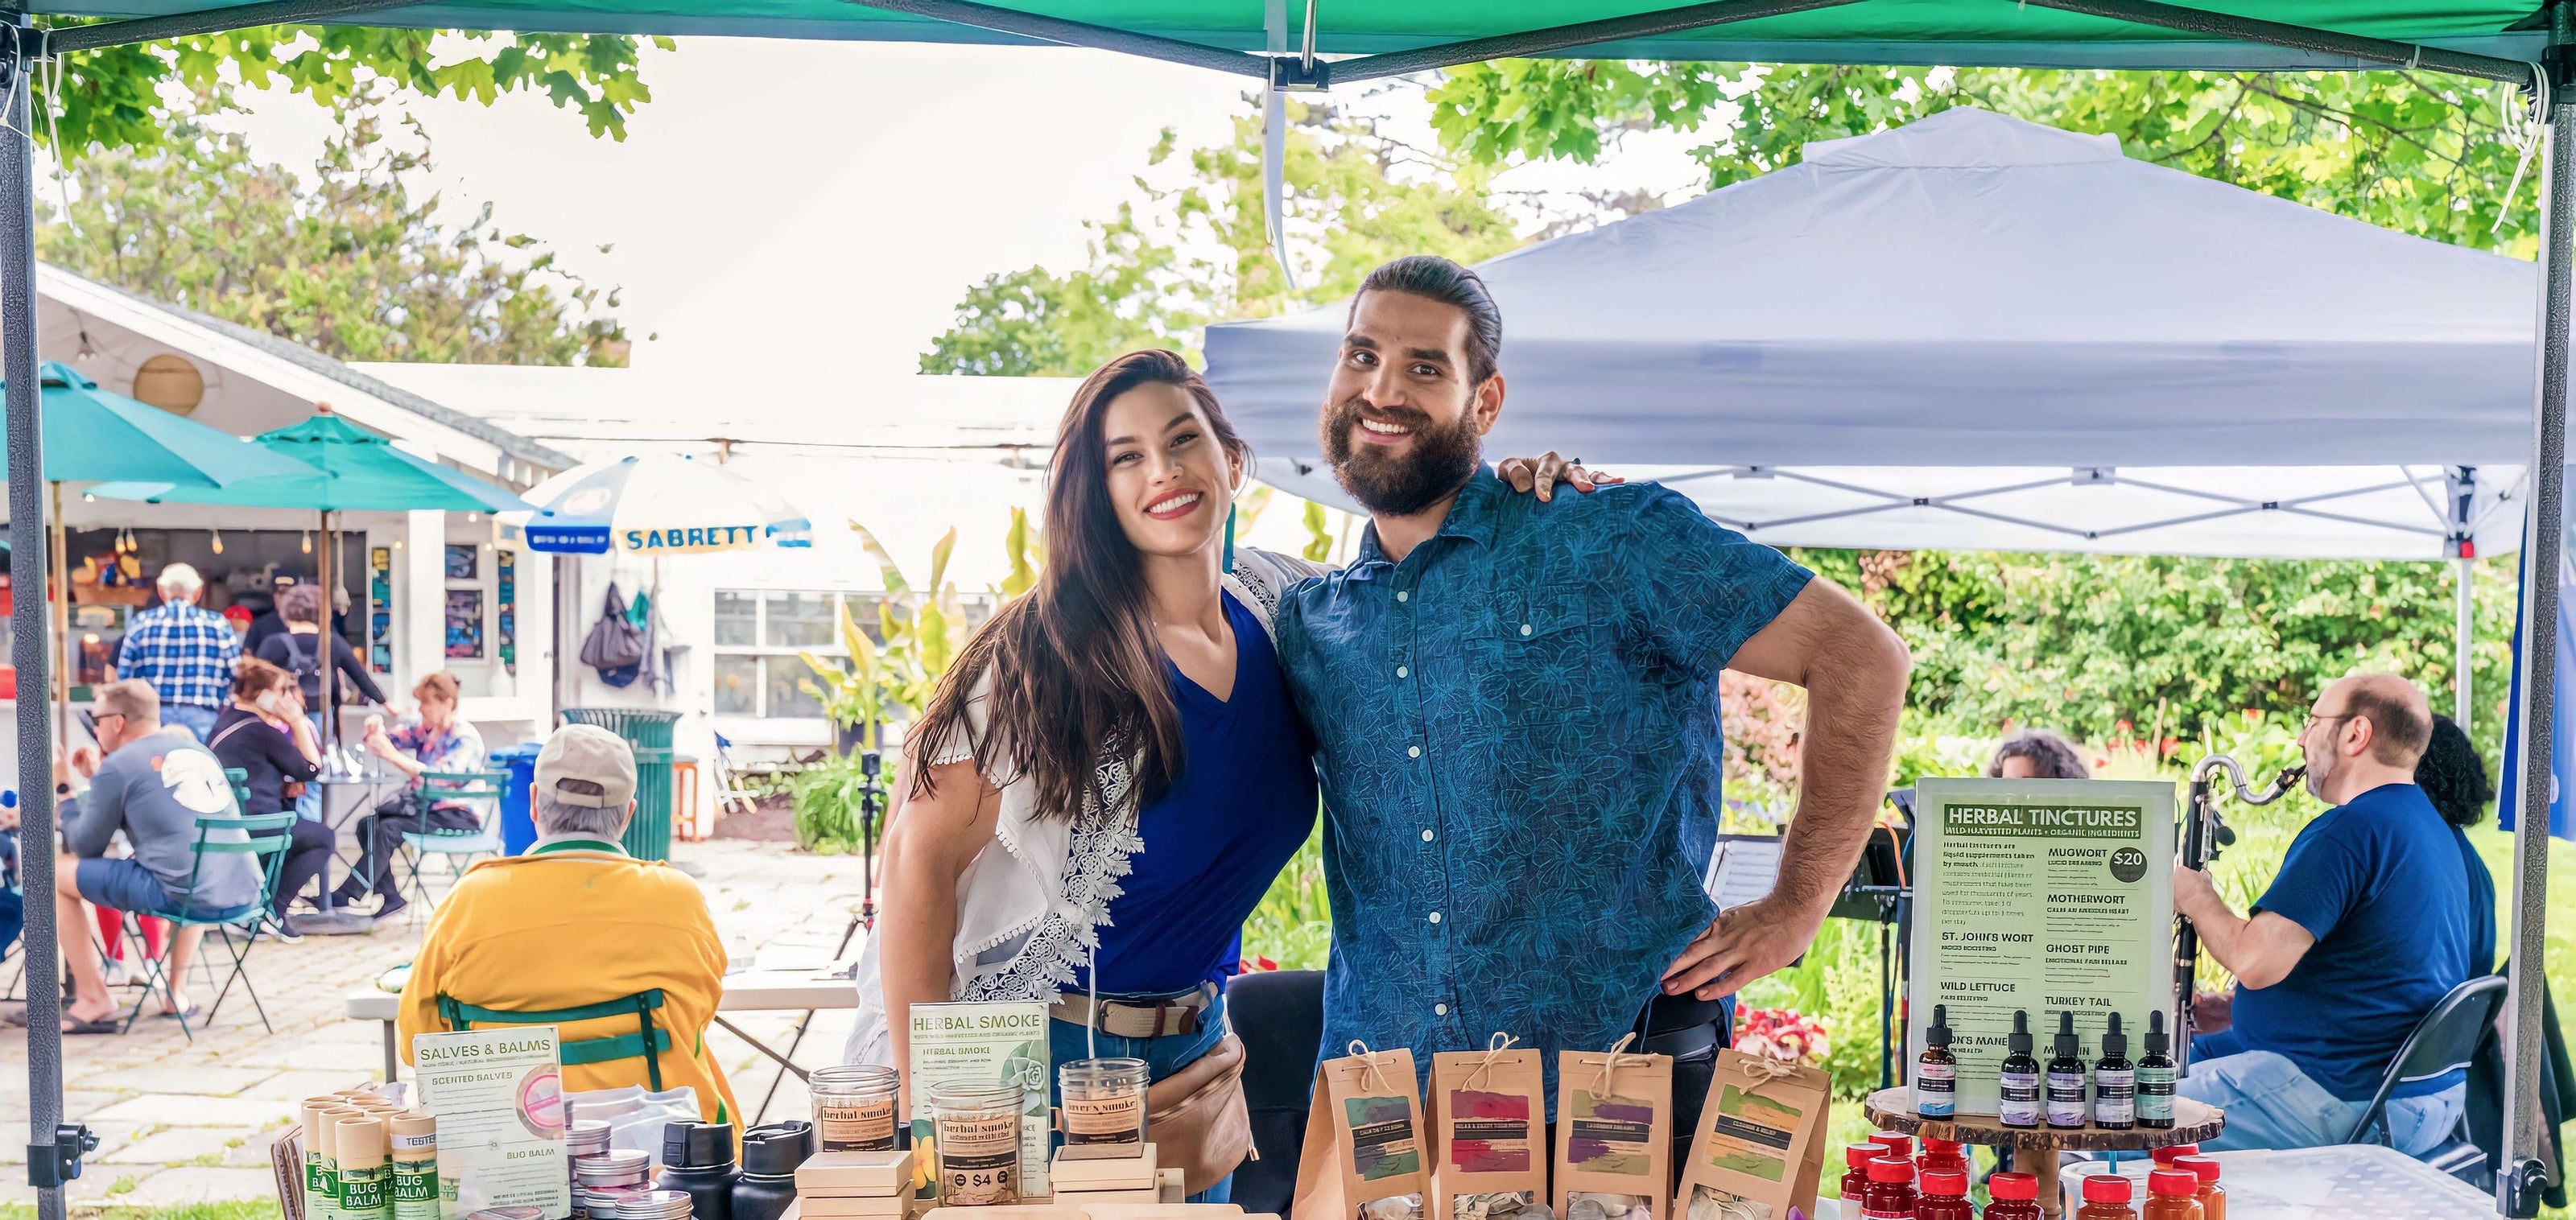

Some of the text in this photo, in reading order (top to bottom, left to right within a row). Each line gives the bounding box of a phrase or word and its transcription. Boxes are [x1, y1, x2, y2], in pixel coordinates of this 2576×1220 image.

[626, 526, 758, 550] SABRETT
[1949, 808, 2136, 826] HERBAL TINCTURES
[2113, 852, 2142, 865] $20
[2047, 894, 2125, 904] MOTHERWORT
[1942, 932, 1958, 941] ST.
[2001, 934, 2033, 942] WORT
[2046, 944, 2110, 954] GHOST PIPE
[1941, 982, 2016, 992] WILD LETTUCE
[2045, 996, 2112, 1007] TURKEY TAIL
[914, 1015, 1040, 1031] HERBAL SMOKE
[1952, 1036, 2008, 1046] ON'S MANE
[420, 1039, 551, 1061] SALVES & BALMS
[396, 1176, 423, 1186] BUG
[972, 1174, 991, 1187] $4
[349, 1183, 378, 1194] BUG
[394, 1186, 428, 1197] BALM
[346, 1193, 382, 1206] BALM
